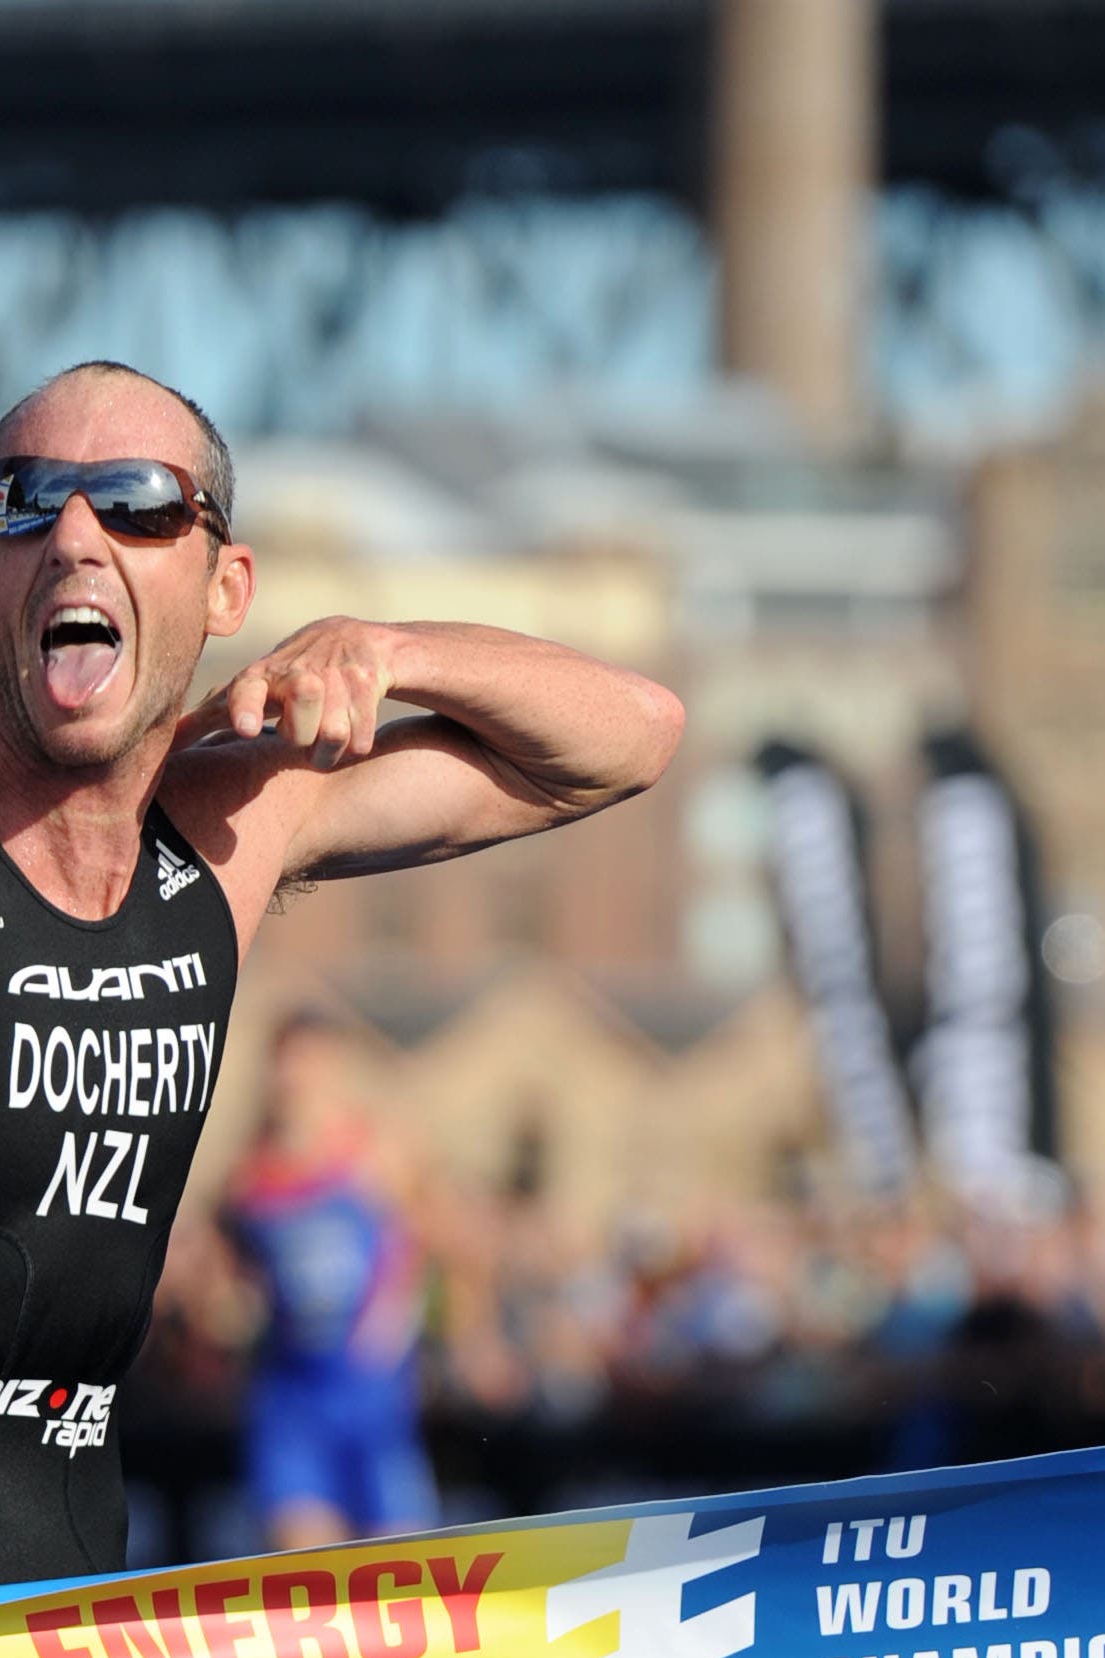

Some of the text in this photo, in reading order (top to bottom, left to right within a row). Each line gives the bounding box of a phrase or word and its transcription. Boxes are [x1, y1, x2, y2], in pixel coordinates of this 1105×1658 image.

[159, 864, 201, 901] adidas
[8, 1021, 216, 1117] DOCHERTY
[36, 1129, 150, 1225] NZL
[41, 1410, 111, 1459] rapid
[822, 1514, 927, 1564] ITU
[816, 1567, 1051, 1636] WORLD
